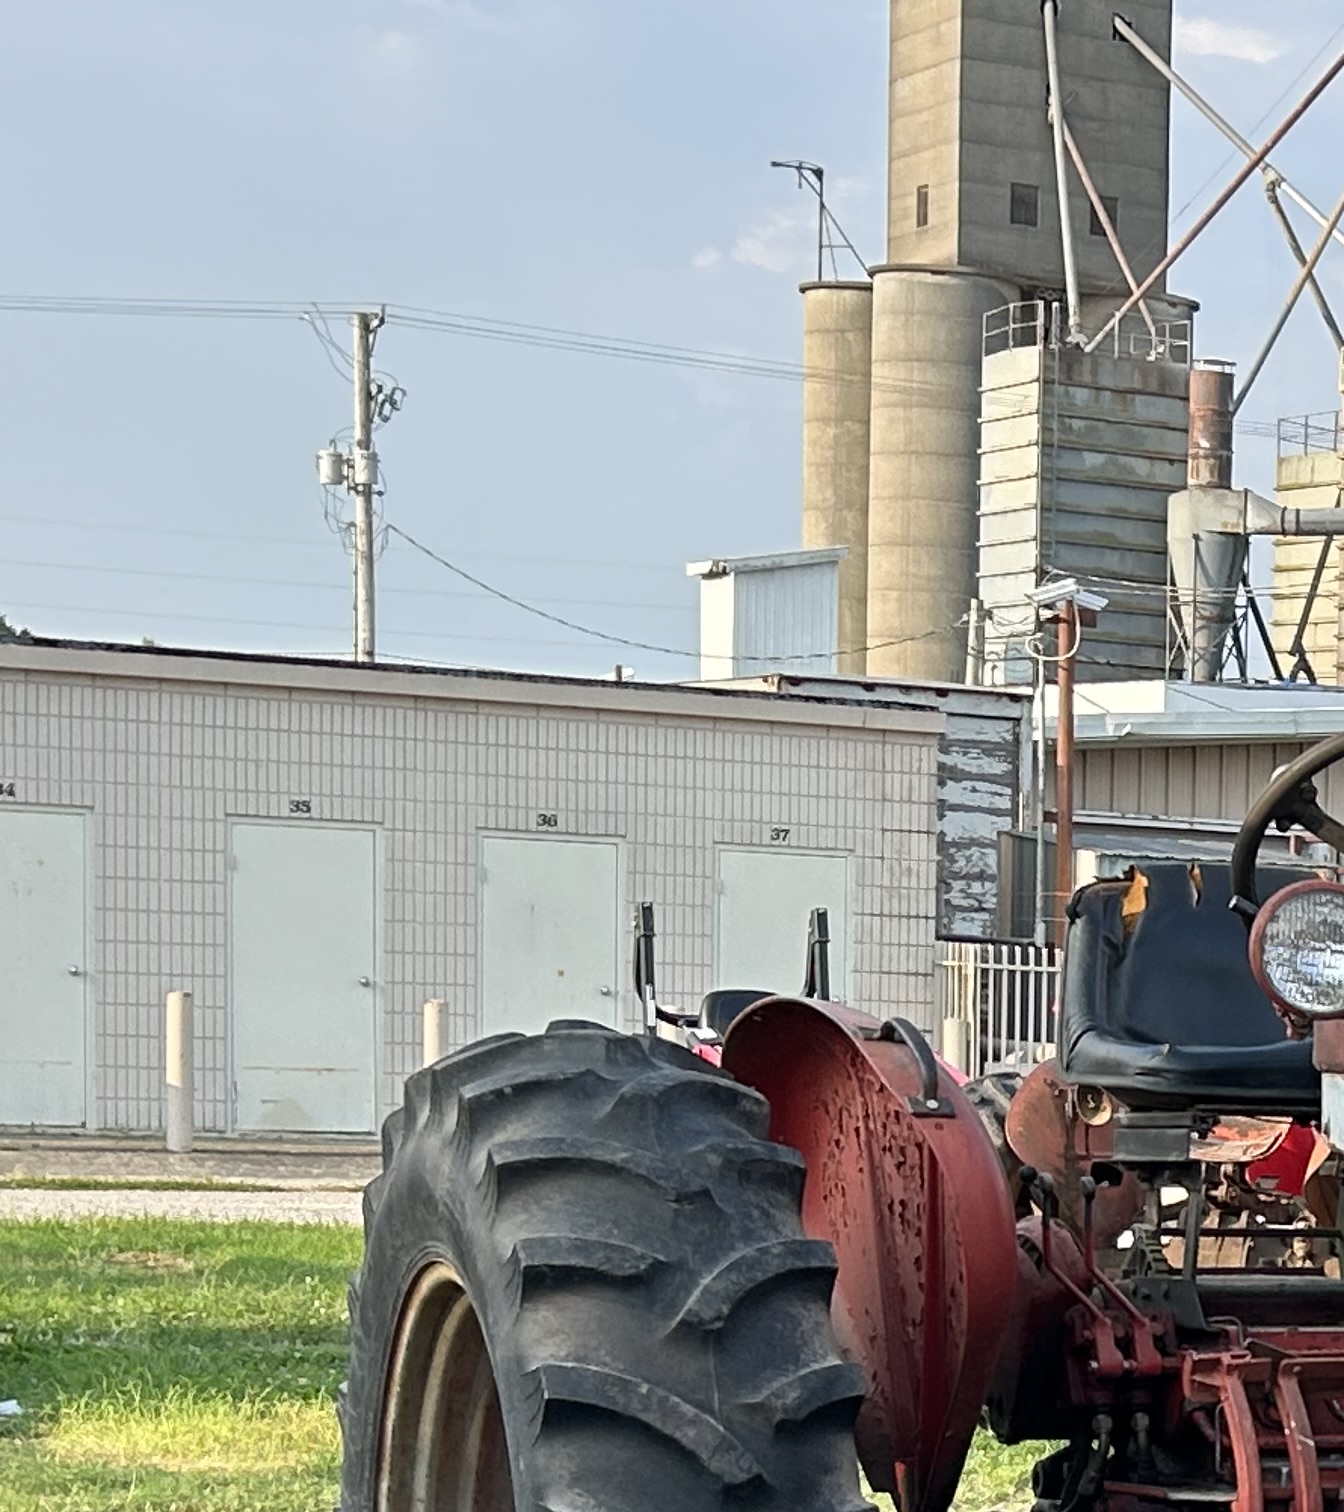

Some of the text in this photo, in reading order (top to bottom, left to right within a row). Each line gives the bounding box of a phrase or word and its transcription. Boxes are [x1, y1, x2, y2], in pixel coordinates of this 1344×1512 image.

[290, 799, 311, 813] 35
[536, 813, 558, 827] 36
[770, 827, 791, 842] 37
